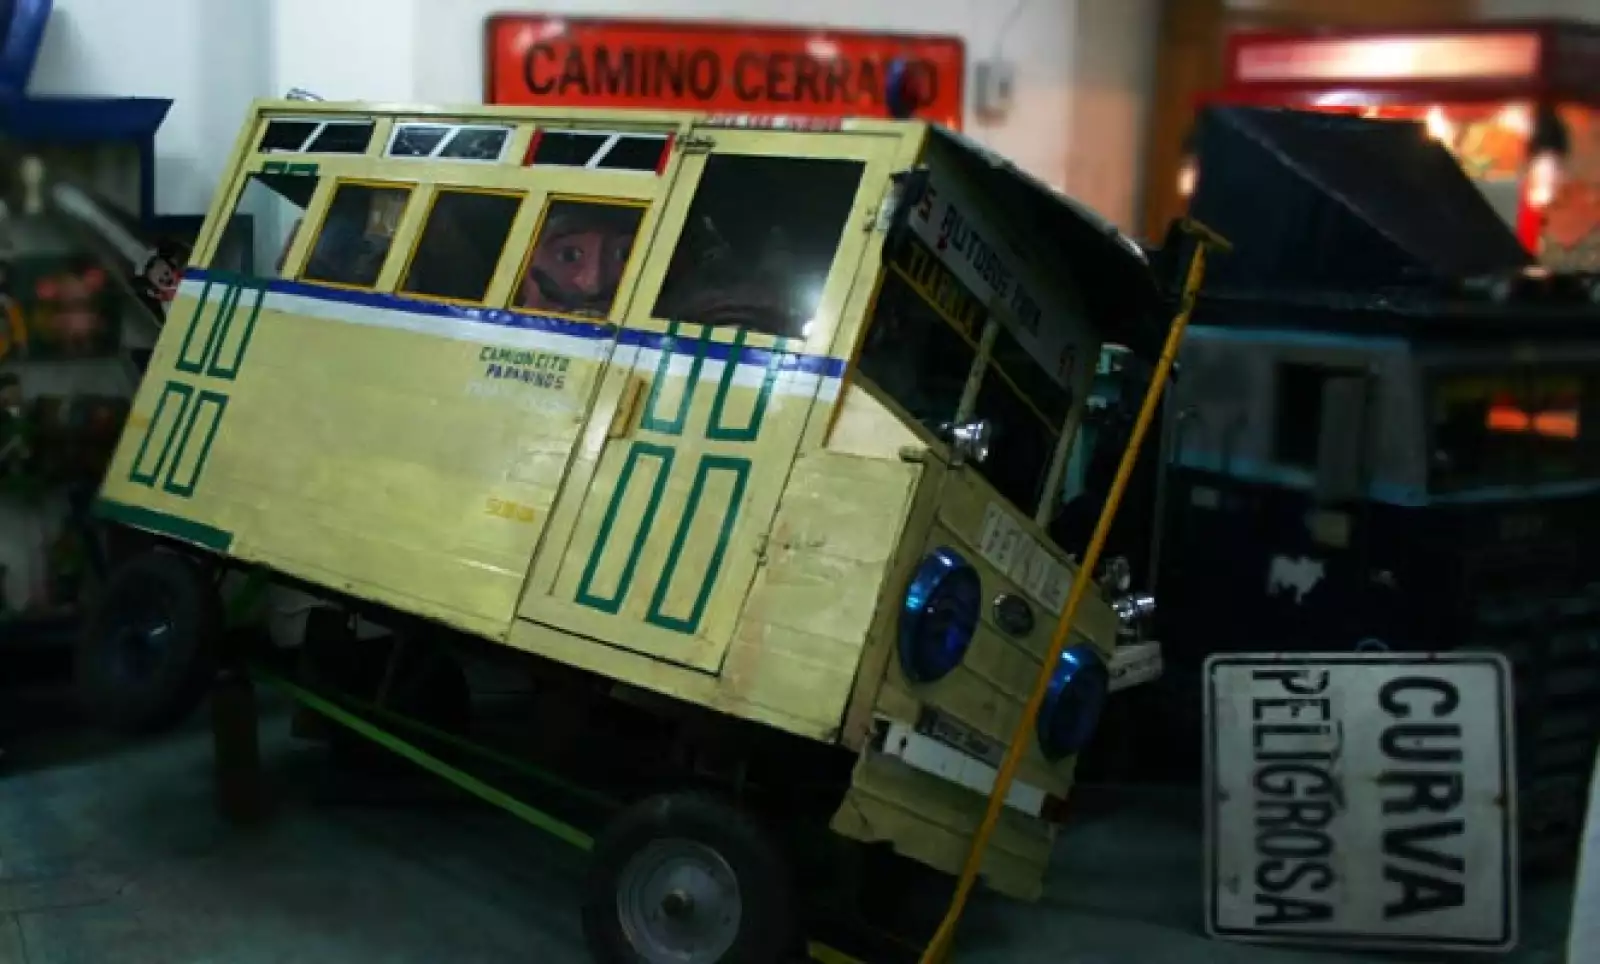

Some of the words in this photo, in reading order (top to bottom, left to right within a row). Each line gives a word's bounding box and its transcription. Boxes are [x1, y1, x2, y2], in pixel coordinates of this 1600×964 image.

[523, 42, 723, 101] CAMINO
[732, 52, 939, 108] CERRAO
[1253, 669, 1334, 925] PELIGROSA
[1378, 676, 1465, 921] CURVA
